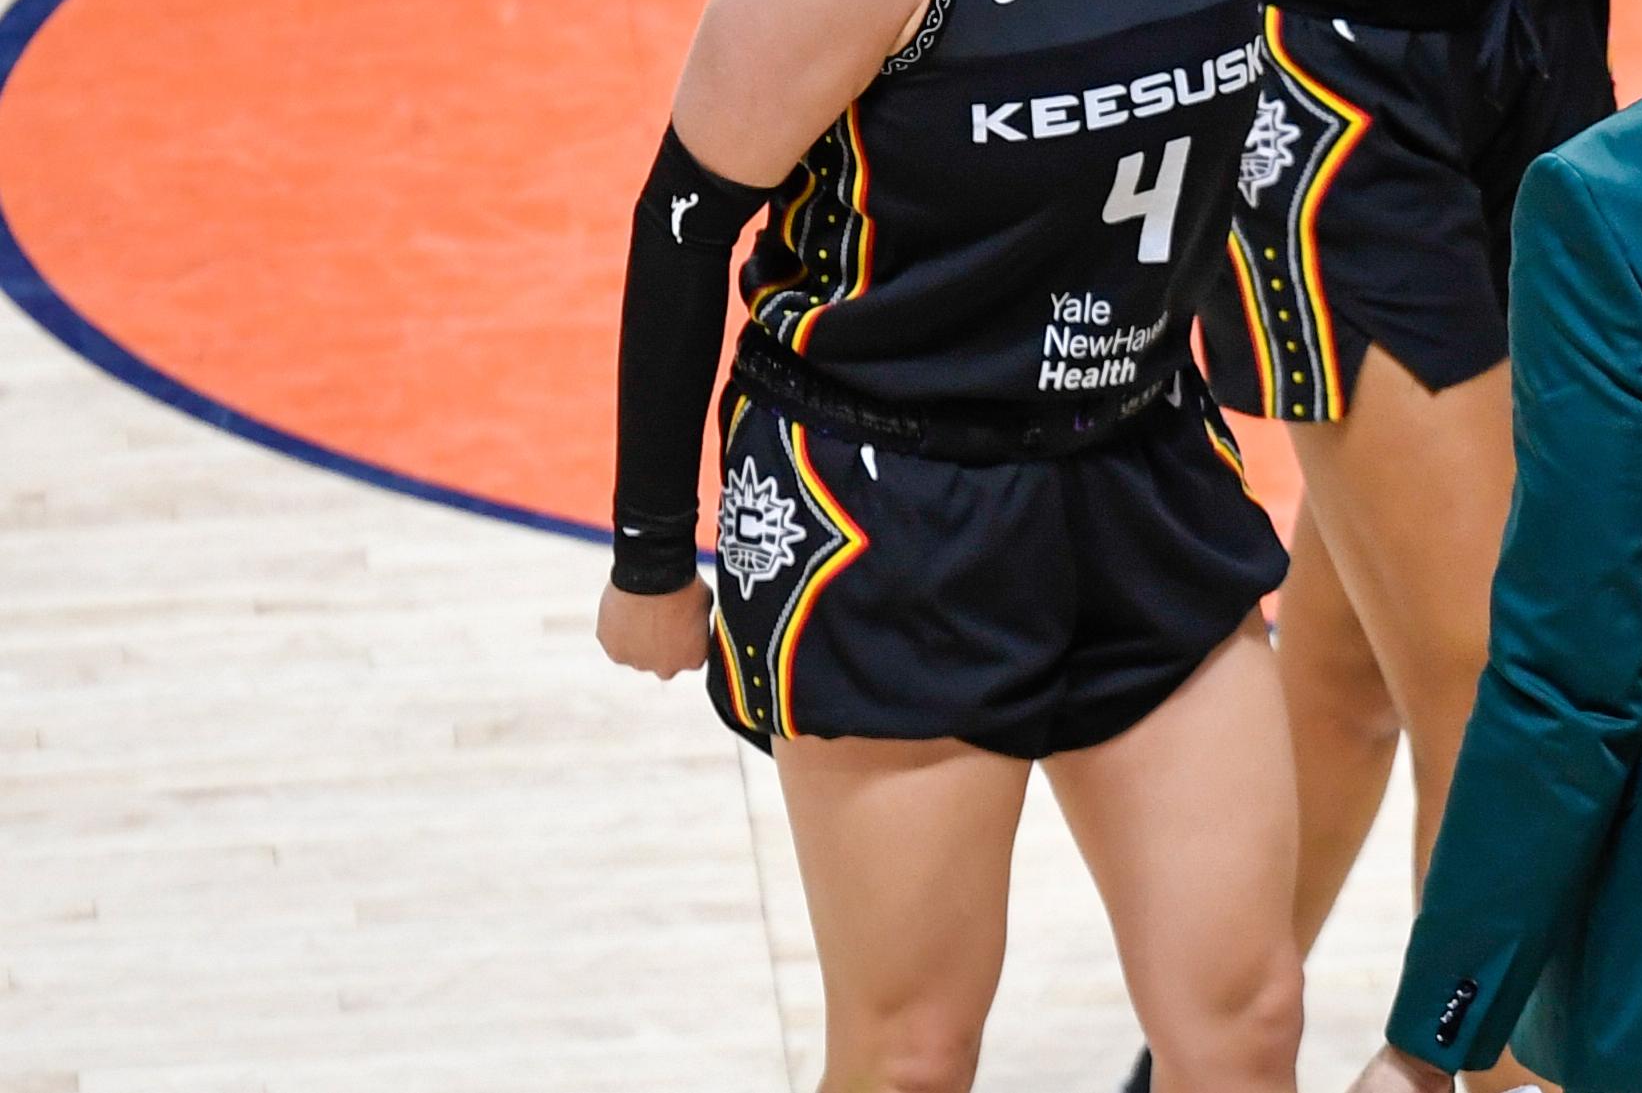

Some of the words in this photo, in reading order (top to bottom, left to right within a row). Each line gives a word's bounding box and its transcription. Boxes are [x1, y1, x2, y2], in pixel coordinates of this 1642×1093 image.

[972, 35, 1263, 144] KEESUSK
[1102, 136, 1192, 264] 4
[1050, 291, 1111, 325] Yale
[1037, 356, 1137, 392] Health
